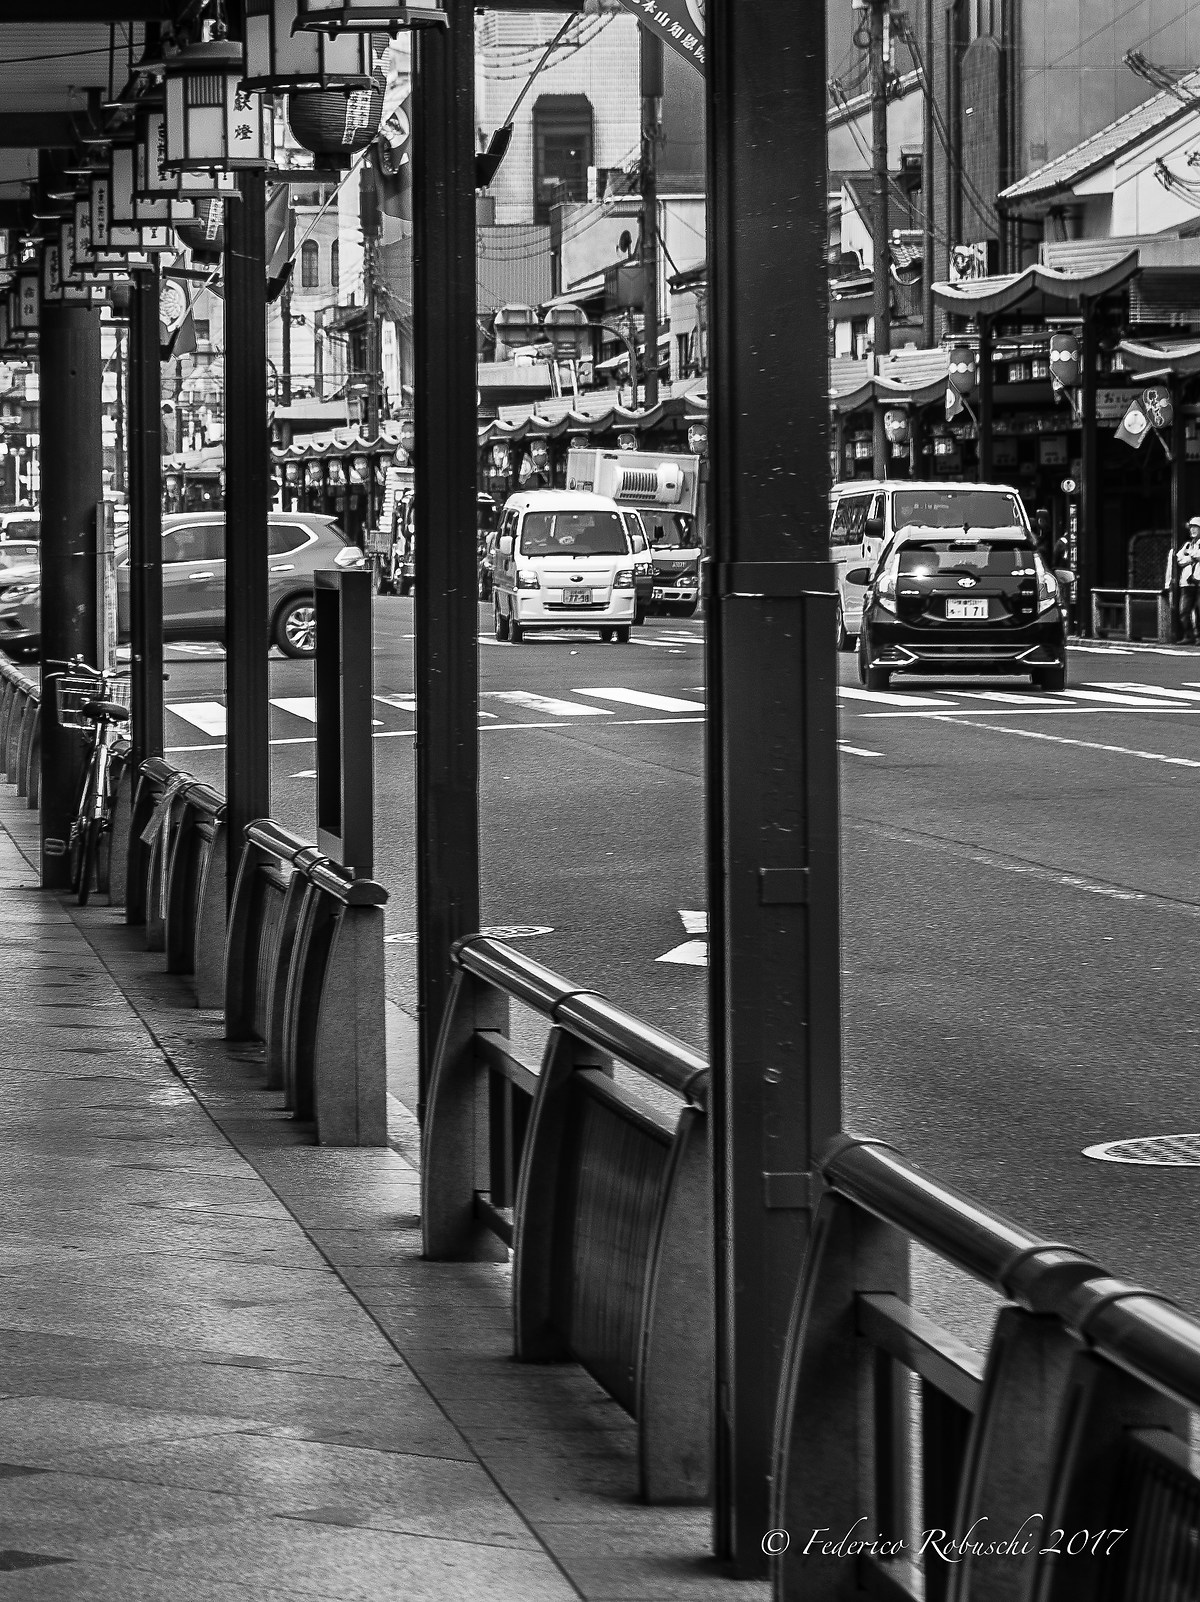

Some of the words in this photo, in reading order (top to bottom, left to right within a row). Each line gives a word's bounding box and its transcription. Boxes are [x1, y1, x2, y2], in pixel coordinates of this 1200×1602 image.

[632, 0, 705, 63] 本山知恩院
